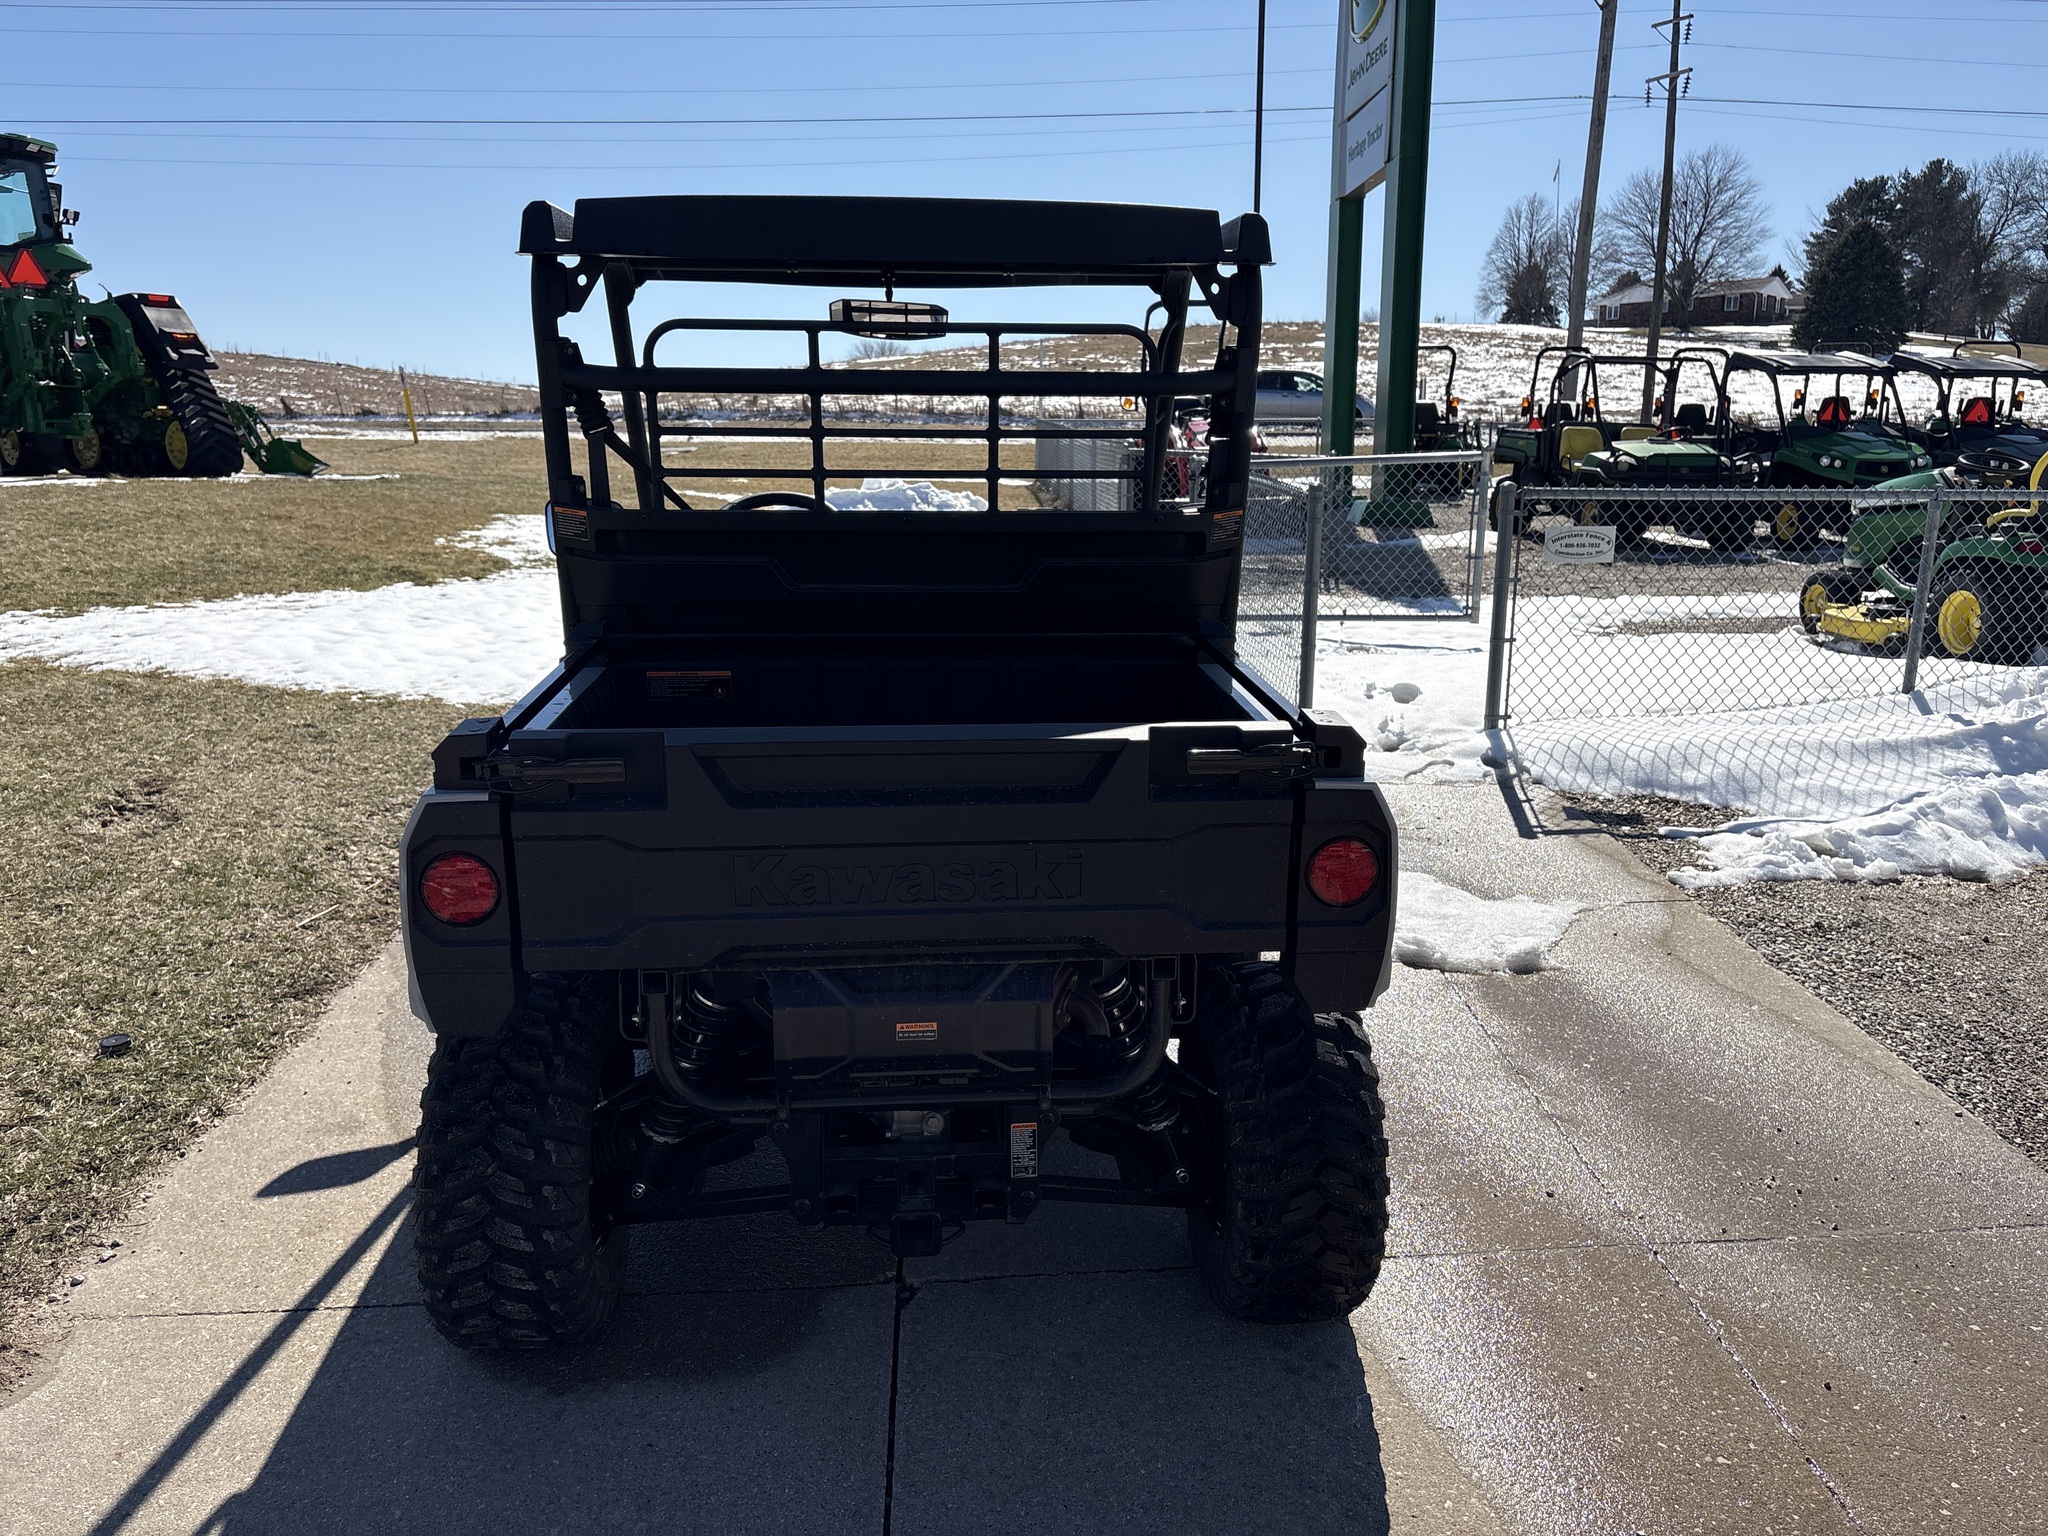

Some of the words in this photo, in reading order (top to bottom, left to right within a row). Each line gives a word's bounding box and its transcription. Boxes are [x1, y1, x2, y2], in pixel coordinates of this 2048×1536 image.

[1348, 60, 1365, 90] JOHN
[1366, 36, 1388, 73] DEERE
[1348, 138, 1366, 164] Heritage
[1367, 123, 1383, 149] Tractor
[1551, 532, 1584, 545] Interstate
[1586, 532, 1605, 542] Fence
[1554, 549, 1585, 557] Construction
[732, 848, 1084, 908] Kawasaki
